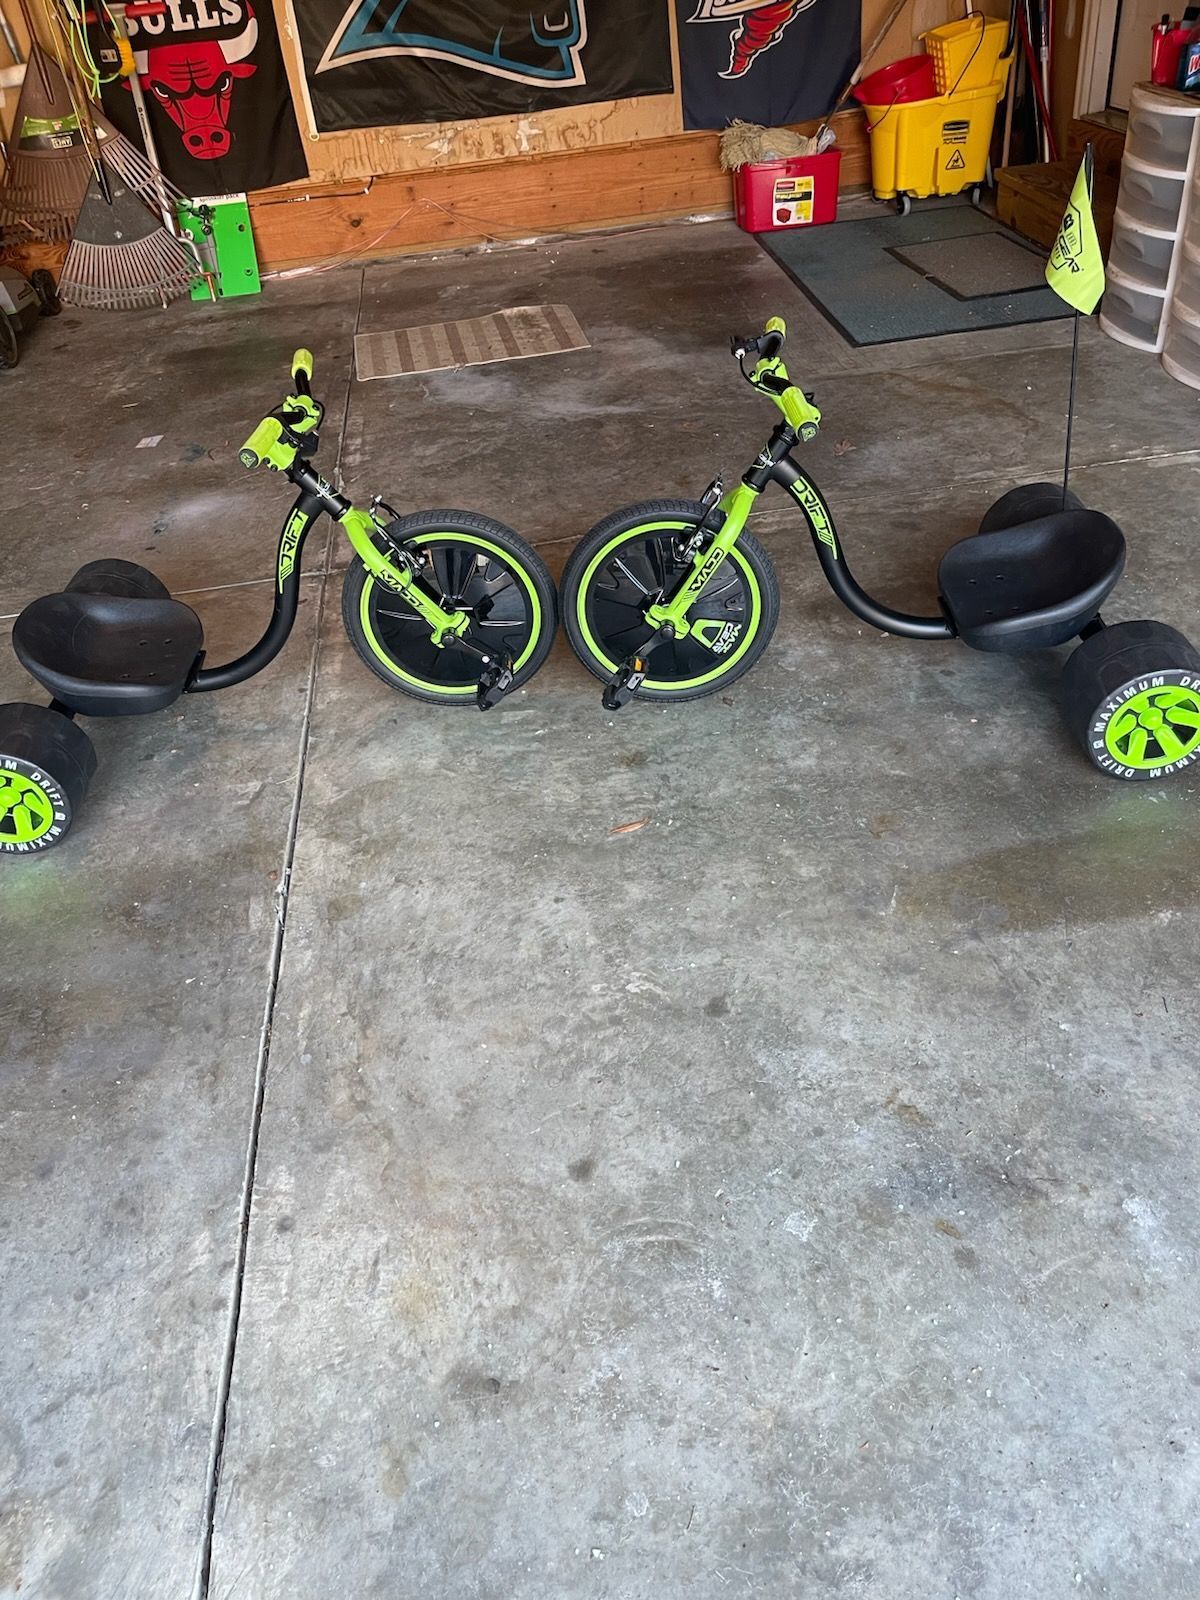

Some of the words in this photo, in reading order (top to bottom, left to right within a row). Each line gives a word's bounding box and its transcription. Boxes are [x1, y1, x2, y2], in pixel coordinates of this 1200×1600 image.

[791, 478, 832, 539] DRIFT
[281, 513, 308, 568] DRIFT
[1093, 676, 1164, 732] MAXIMUM
[30, 772, 64, 806] DRIFT
[1097, 753, 1135, 778] DRIFT
